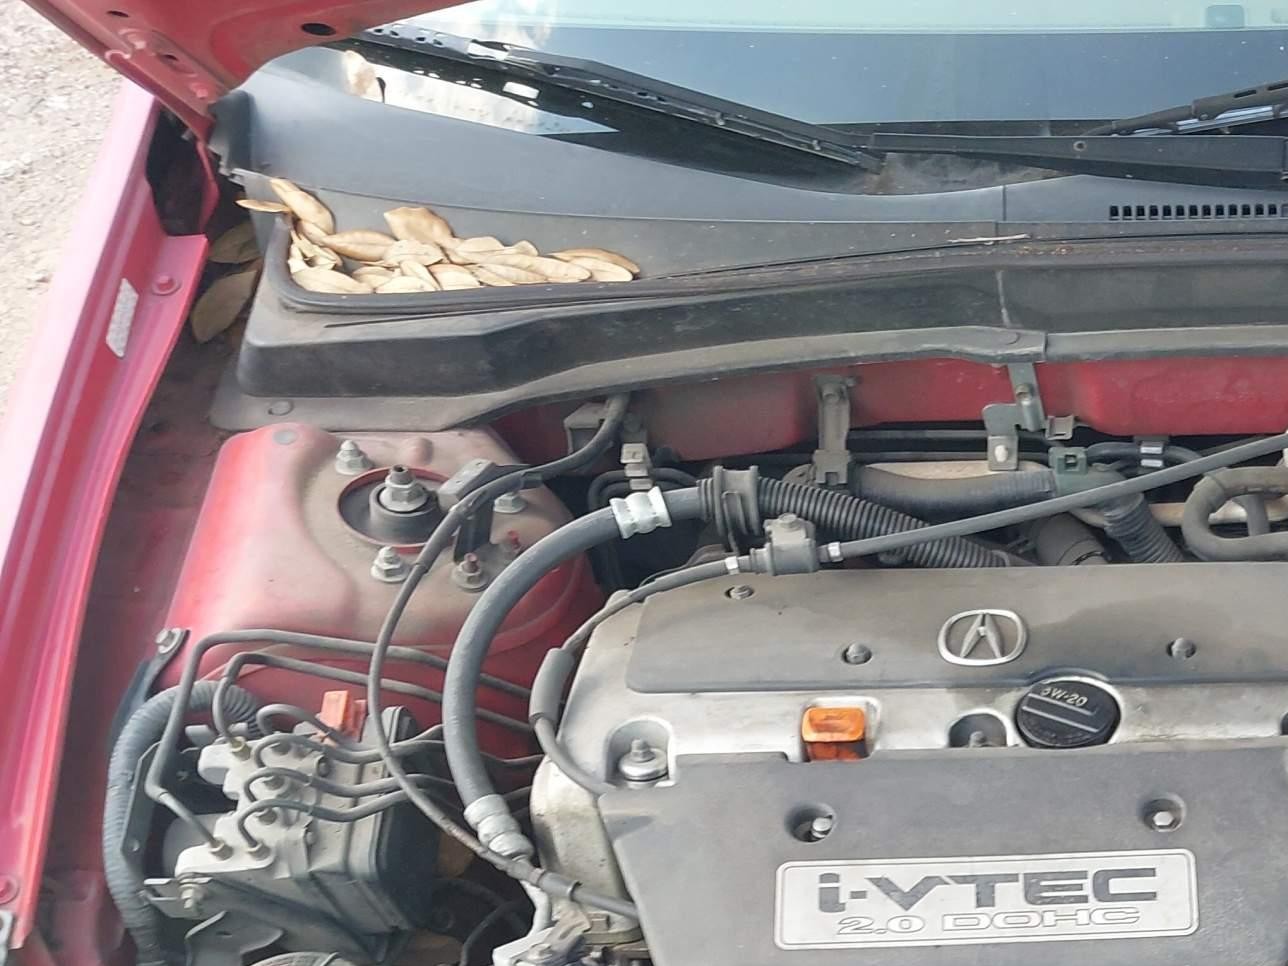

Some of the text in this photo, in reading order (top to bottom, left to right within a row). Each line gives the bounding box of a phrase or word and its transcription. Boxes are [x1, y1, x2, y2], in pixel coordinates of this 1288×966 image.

[818, 867, 1157, 914] i-VTEC
[837, 906, 1141, 935] 2.0 DOHC
